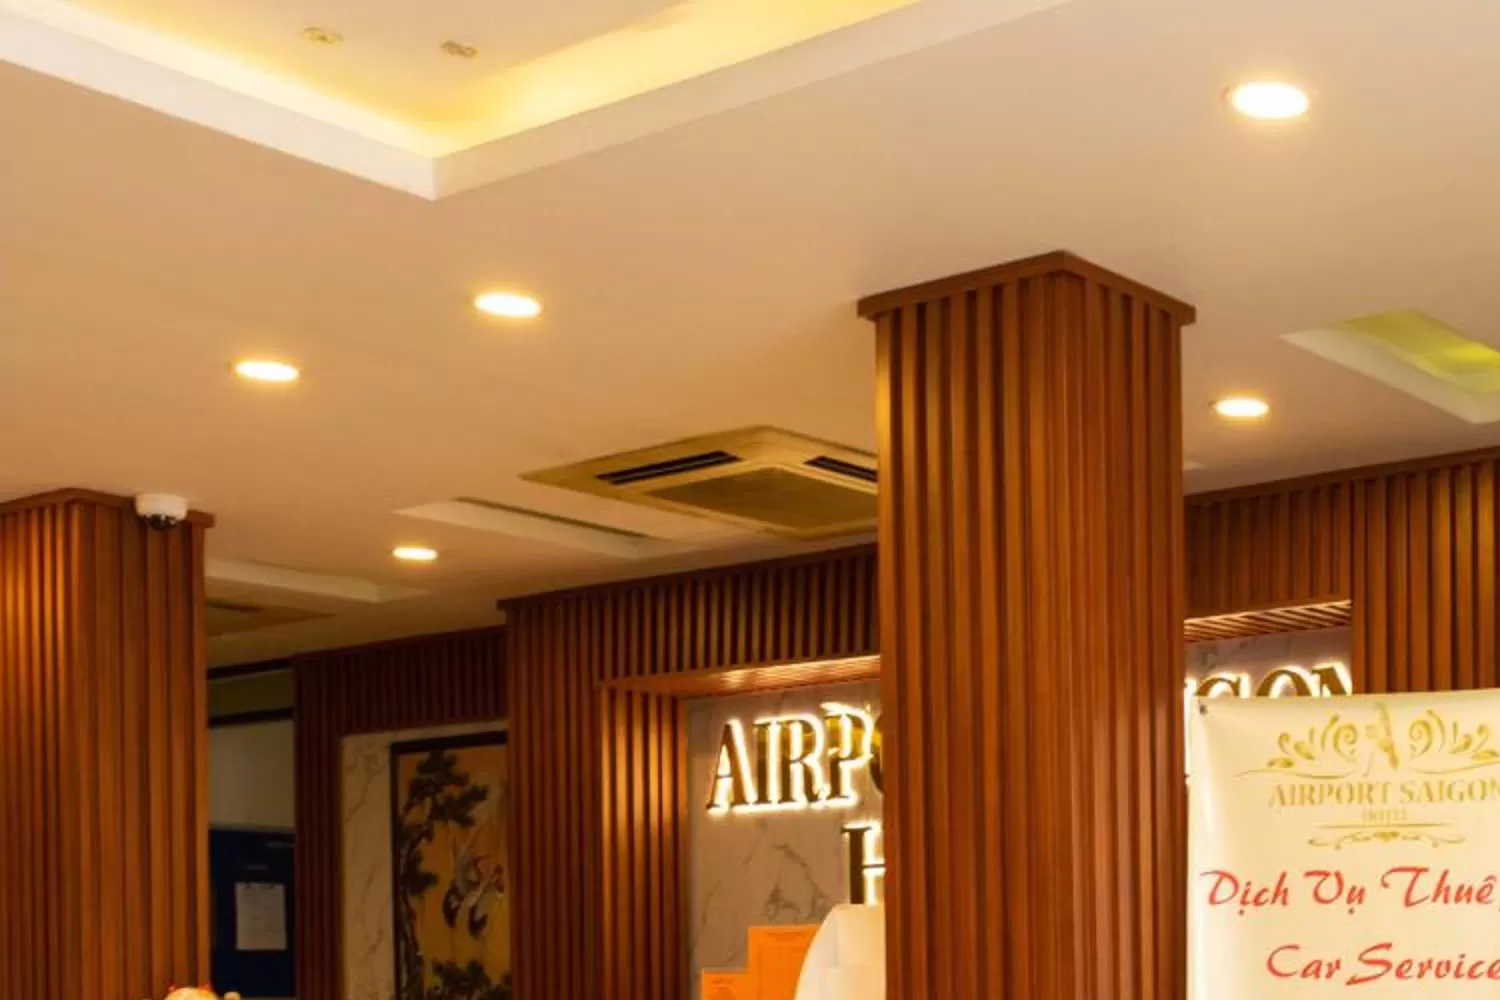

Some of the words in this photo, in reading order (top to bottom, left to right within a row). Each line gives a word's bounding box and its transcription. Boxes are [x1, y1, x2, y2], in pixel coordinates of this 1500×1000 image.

[1268, 781, 1393, 808] AIRPORT
[1200, 870, 1289, 916] Dịch
[1304, 869, 1366, 915] Vụ
[1380, 865, 1497, 908] Thuê
[1266, 944, 1341, 978] Car
